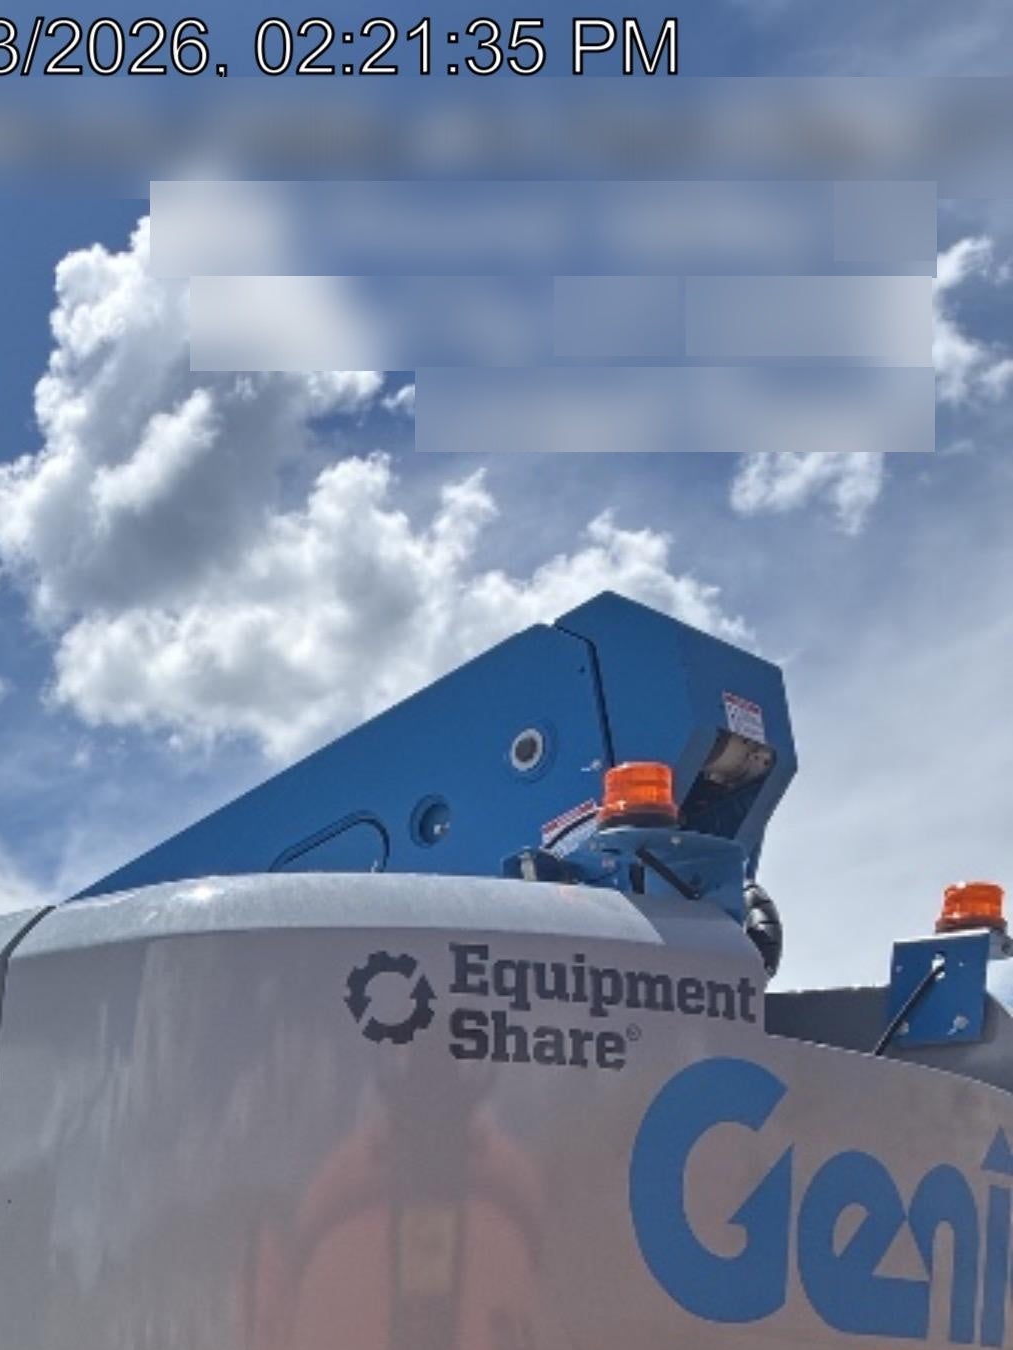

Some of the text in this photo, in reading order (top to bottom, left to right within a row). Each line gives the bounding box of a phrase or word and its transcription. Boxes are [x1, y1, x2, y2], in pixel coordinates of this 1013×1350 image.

[449, 943, 756, 1023] Equipment
[449, 1009, 626, 1070] Share
[630, 1056, 1013, 1348] Geni
